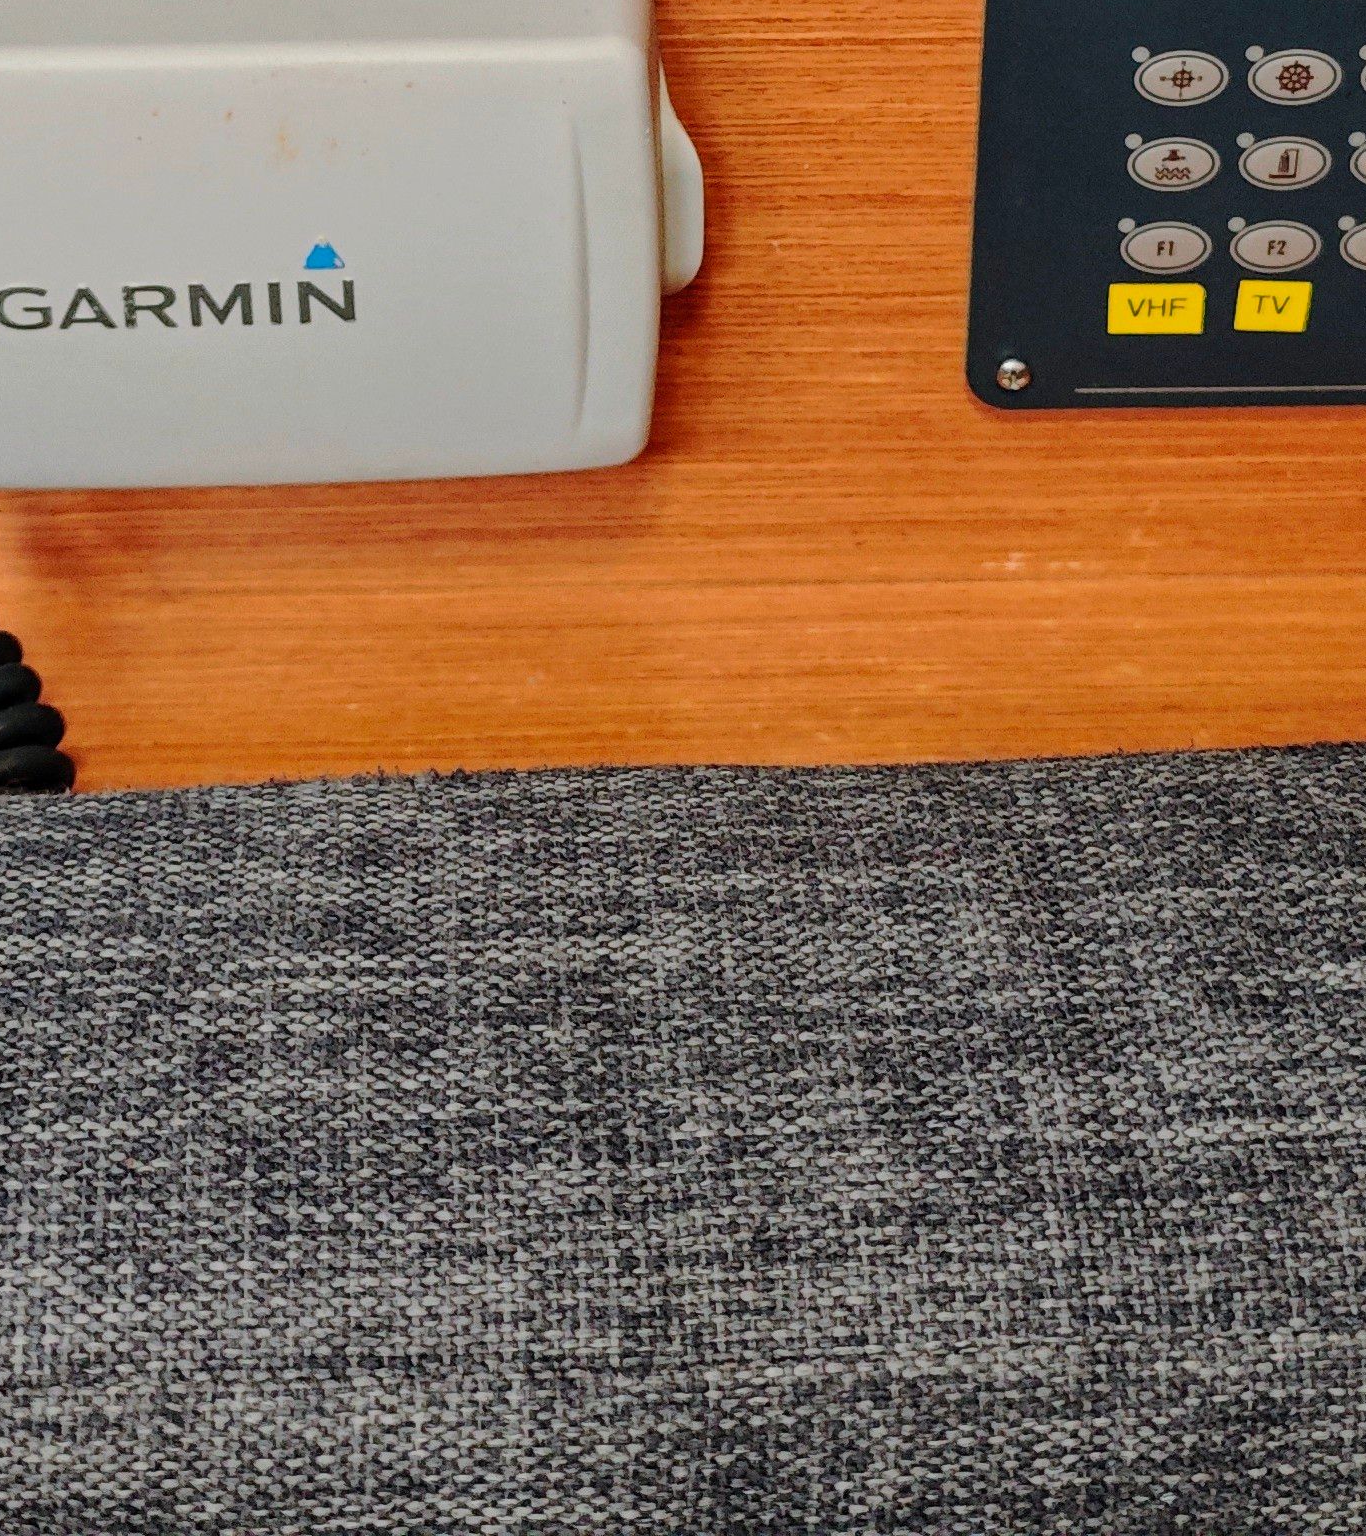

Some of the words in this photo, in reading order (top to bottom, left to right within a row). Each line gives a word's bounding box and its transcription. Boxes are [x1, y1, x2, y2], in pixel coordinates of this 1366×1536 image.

[1156, 240, 1175, 257] F1
[1266, 239, 1288, 256] F2
[1127, 297, 1188, 317] VHF
[1252, 295, 1291, 314] TV
